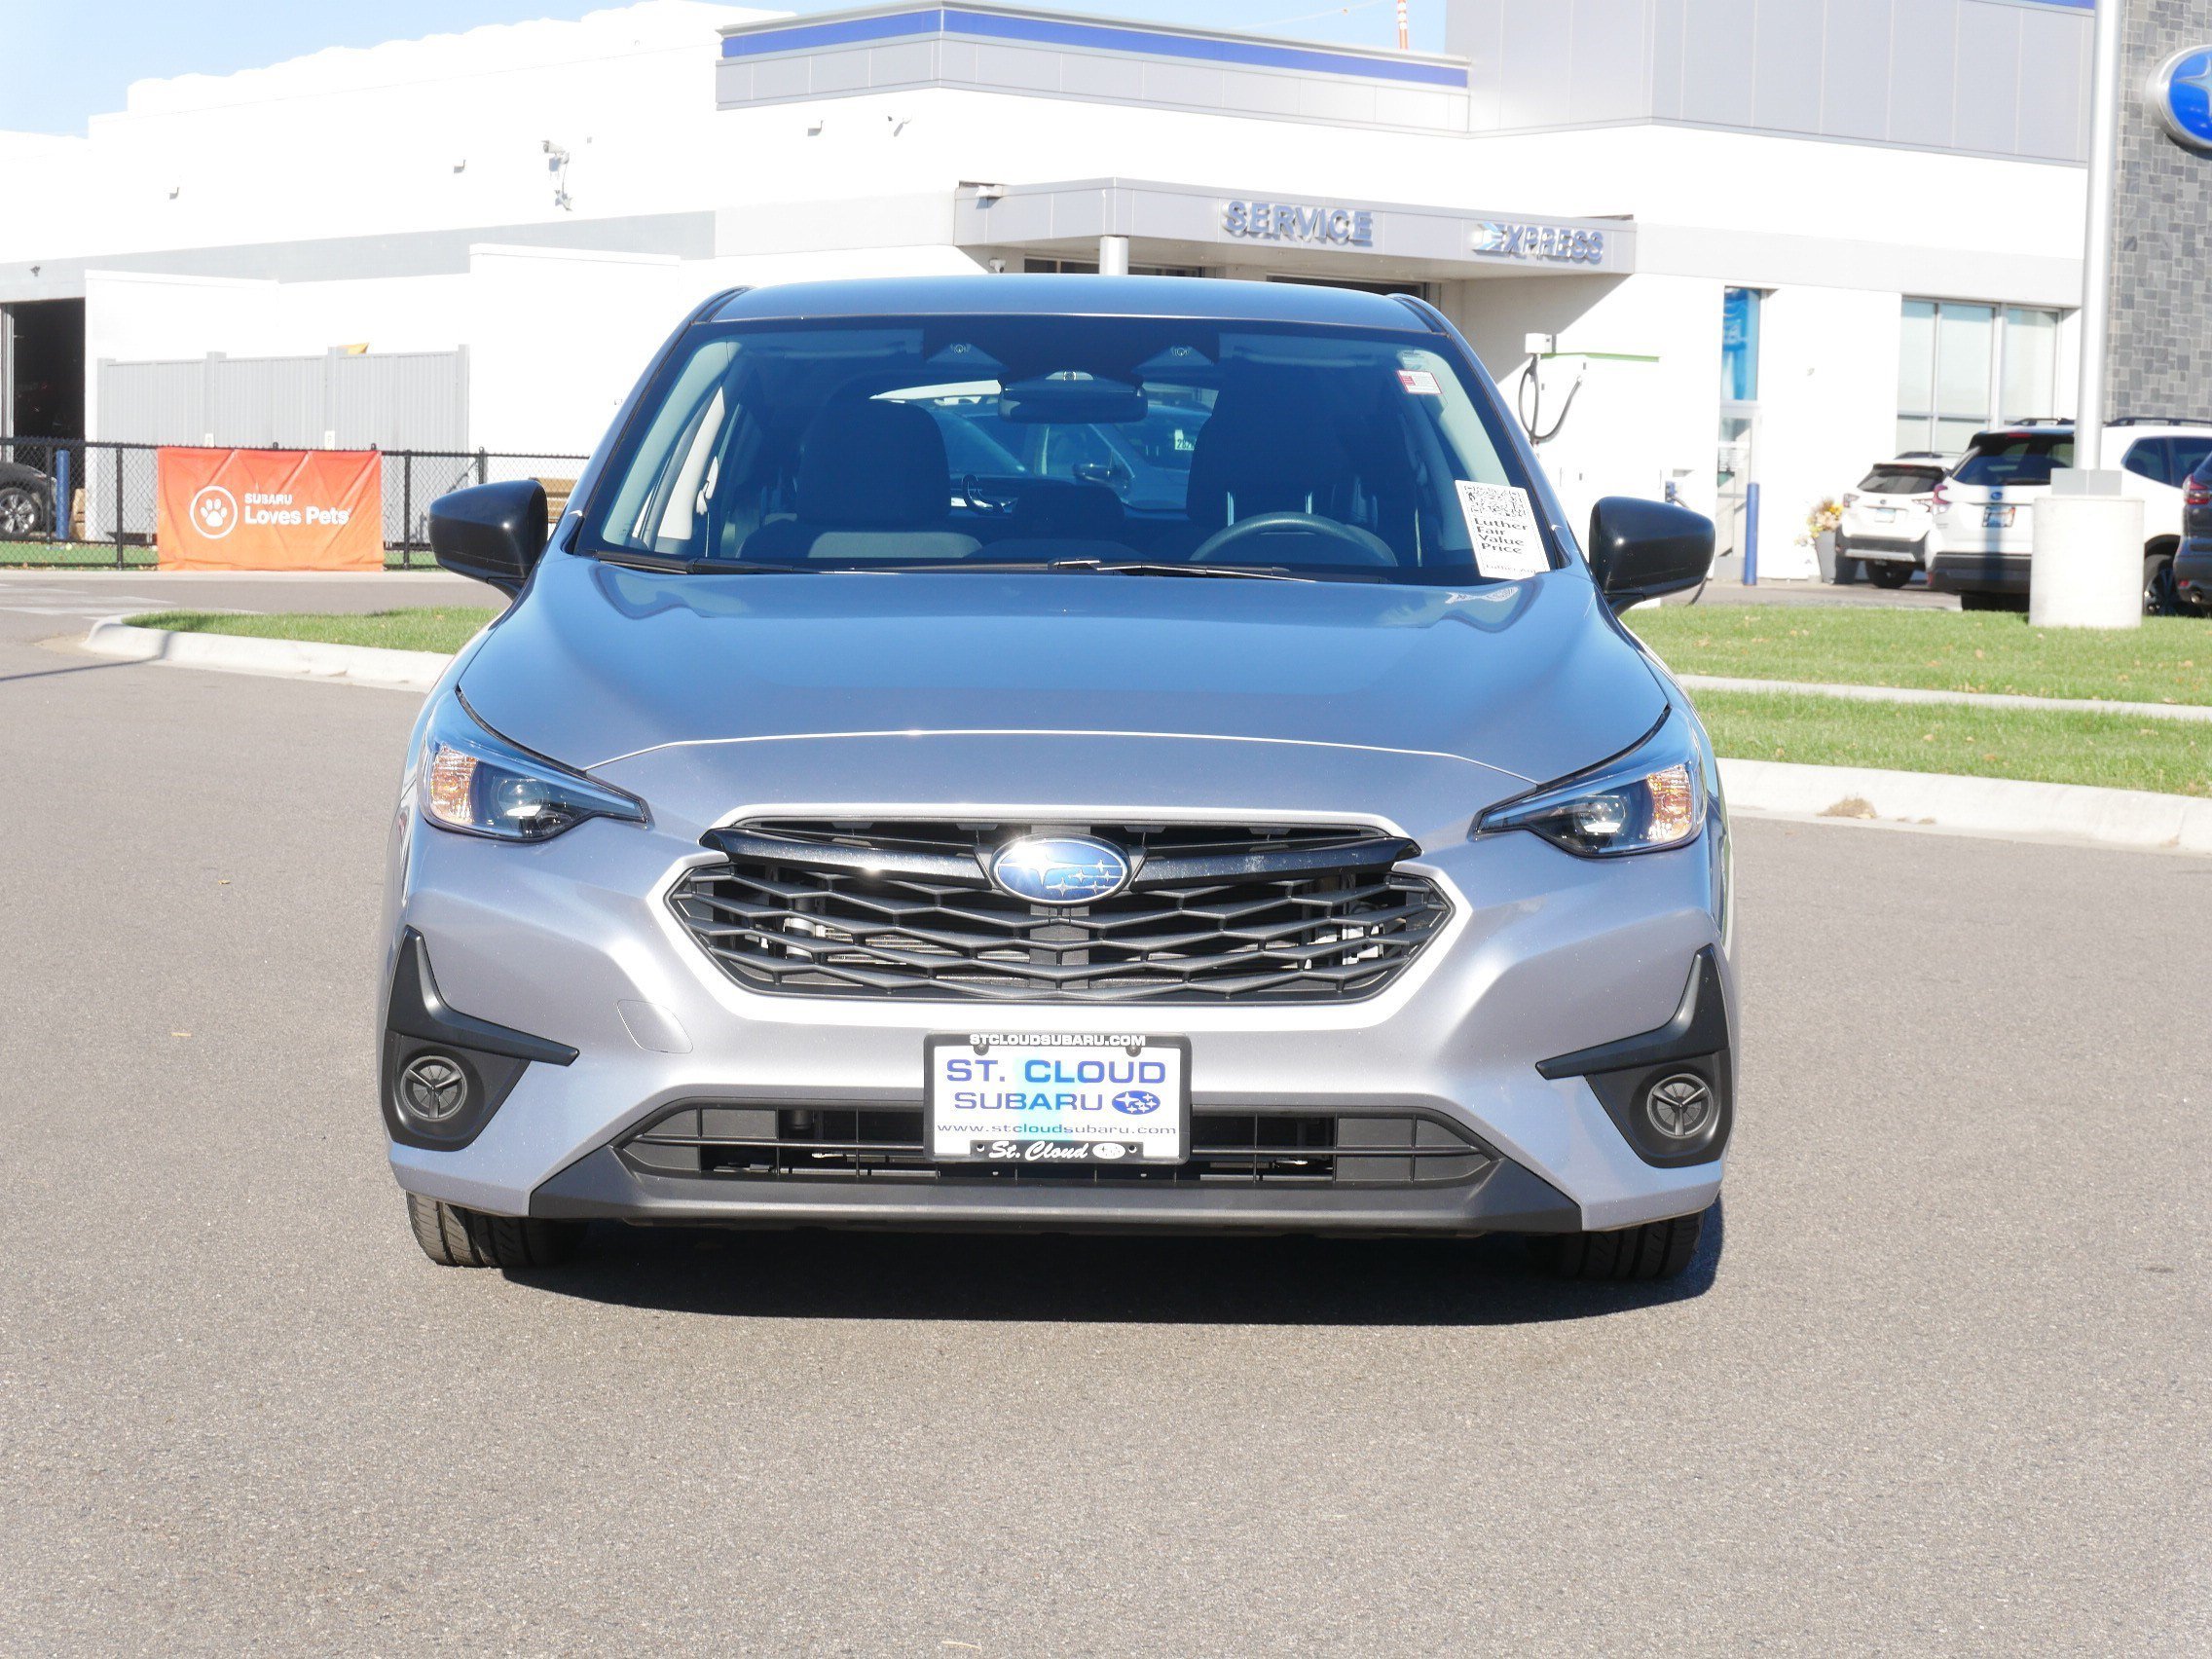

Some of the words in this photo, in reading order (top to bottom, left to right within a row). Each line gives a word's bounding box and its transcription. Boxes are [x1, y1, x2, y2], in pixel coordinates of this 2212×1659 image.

[1224, 201, 1373, 243] SERVICE
[1479, 222, 1604, 260] EXPRESS
[244, 493, 292, 504] SUBARU
[244, 505, 302, 525] Loves
[306, 505, 350, 525] Pets
[1474, 517, 1528, 531] Luther
[1476, 526, 1505, 535] Fair
[1478, 534, 1524, 546] Value
[1481, 542, 1522, 554] Price
[970, 1034, 1146, 1047] STCLOUDSUBARU.COM
[946, 1059, 1005, 1082] ST.
[1024, 1059, 1165, 1084] CLOUD
[954, 1092, 1102, 1111] SUBARU
[937, 1124, 1176, 1135] www.stcloudsubaru.com
[988, 1140, 1021, 1160] St.
[1024, 1140, 1088, 1161] Cloud
